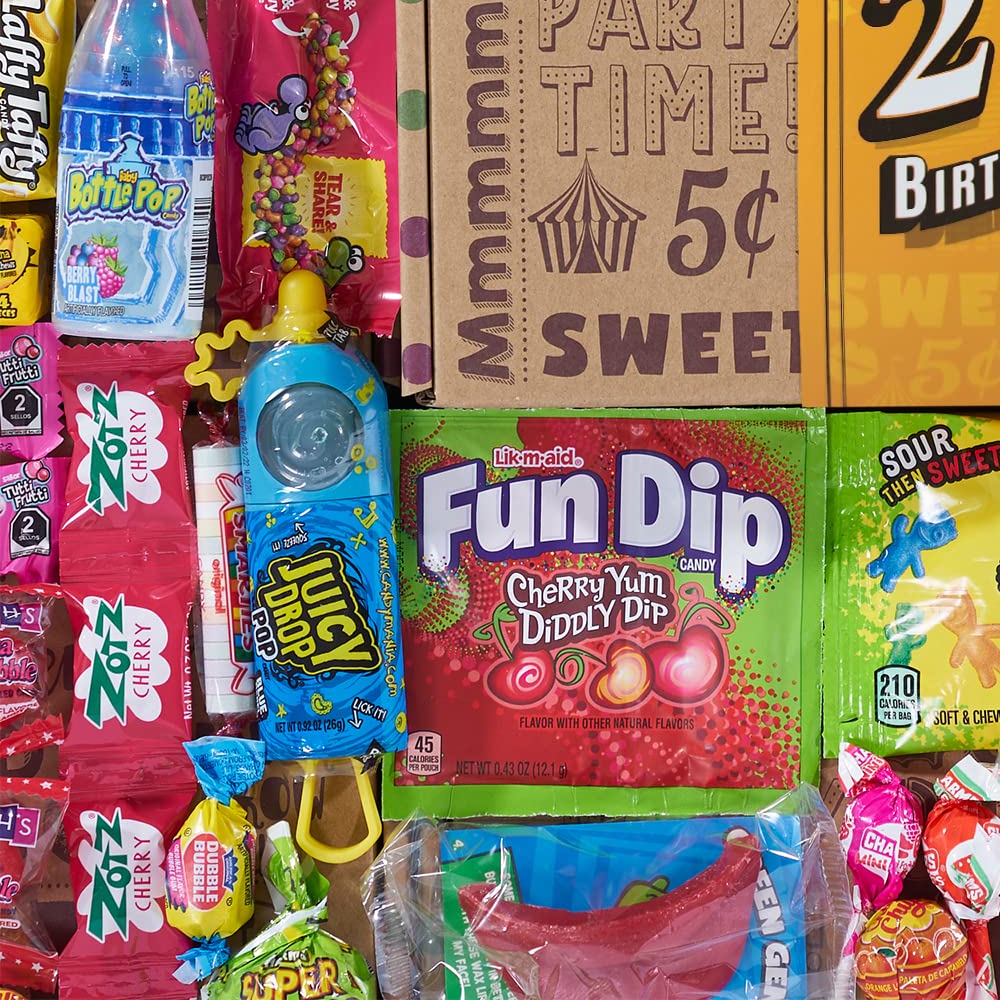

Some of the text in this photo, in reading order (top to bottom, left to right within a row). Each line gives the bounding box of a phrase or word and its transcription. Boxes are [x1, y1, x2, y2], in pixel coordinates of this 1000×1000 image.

[666, 167, 779, 279] 5¢
[67, 267, 98, 283] BERRY
[68, 286, 98, 302] BLAST
[130, 408, 147, 483] CHERRY
[880, 427, 954, 479] SOUR
[882, 470, 924, 504] THEN
[422, 452, 783, 593] Fun Dip
[605, 565, 667, 598] Yum
[679, 557, 716, 572] CANDY
[252, 607, 278, 661] POP
[264, 583, 316, 658] DROP
[278, 557, 373, 666] JUICY
[132, 623, 152, 698] CHERRY
[879, 674, 915, 698] 210
[353, 700, 370, 714] LICK
[519, 717, 694, 729] FLAVOR WITH OTHER NATURAL FLAVORS
[933, 711, 960, 725] SOFT
[414, 736, 434, 753] 45
[133, 836, 152, 911] CHERRY
[193, 840, 205, 903] BUBBLE
[206, 841, 218, 903] DUBBLE
